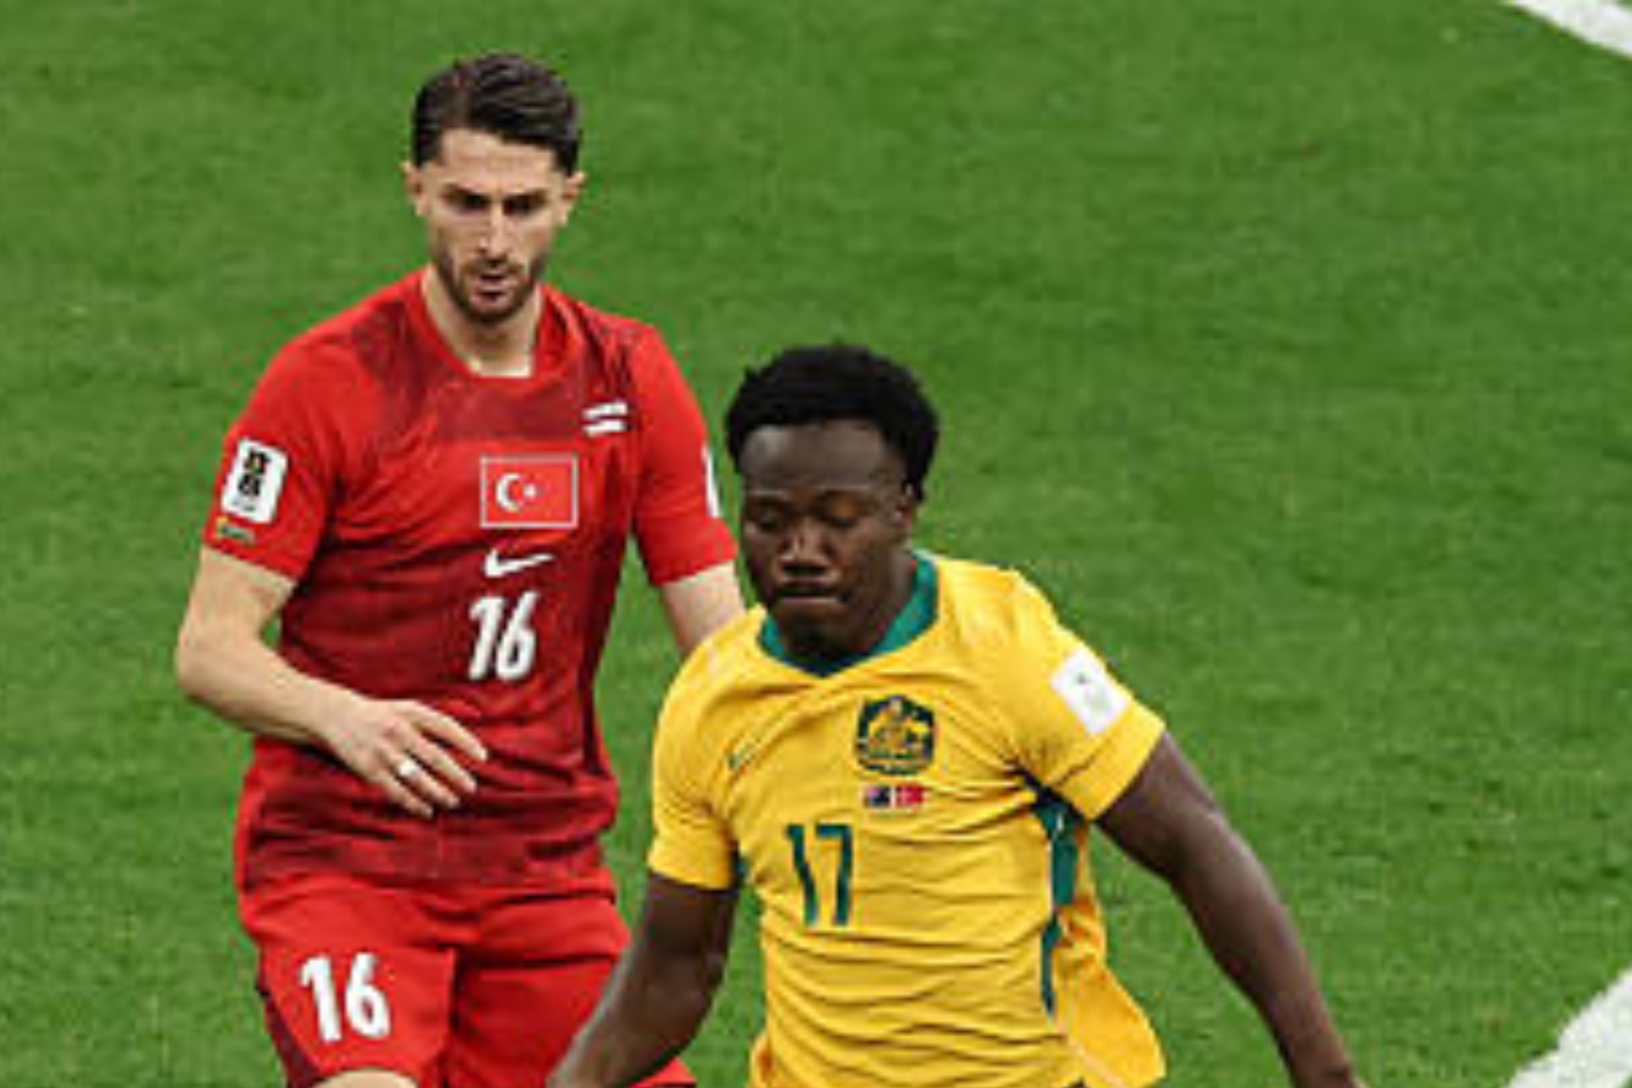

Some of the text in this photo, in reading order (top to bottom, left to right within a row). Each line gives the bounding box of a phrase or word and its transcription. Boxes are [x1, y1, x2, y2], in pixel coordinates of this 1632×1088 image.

[469, 591, 540, 680] 16
[785, 823, 853, 927] 17
[300, 952, 391, 1041] 16
